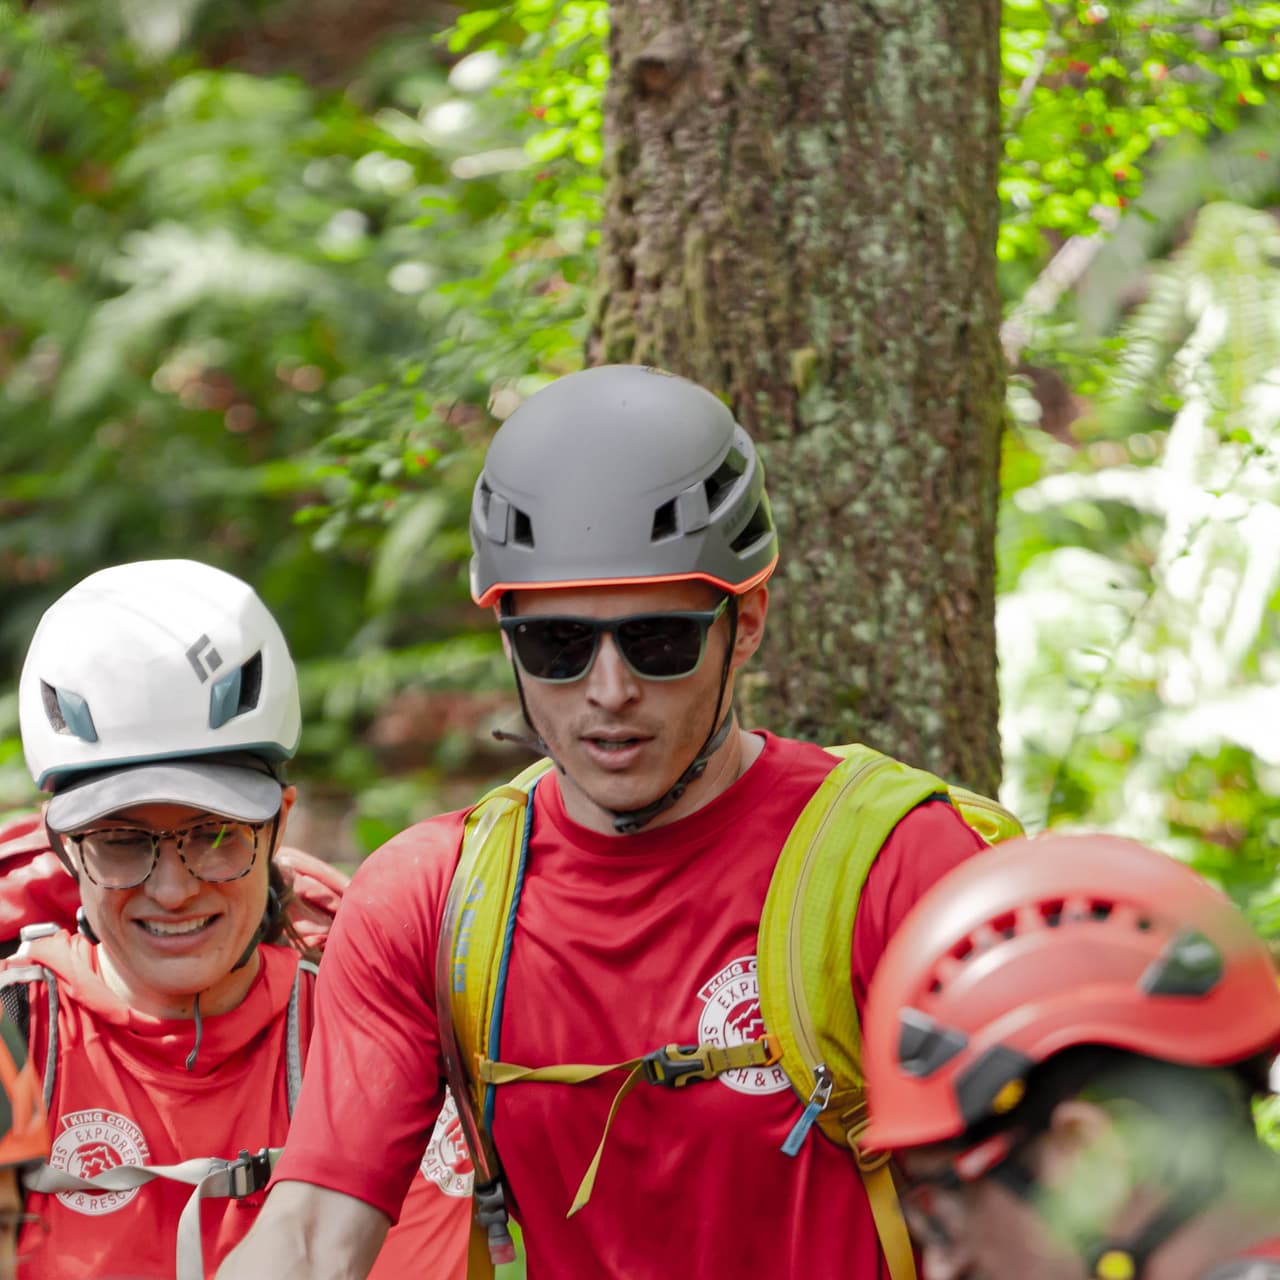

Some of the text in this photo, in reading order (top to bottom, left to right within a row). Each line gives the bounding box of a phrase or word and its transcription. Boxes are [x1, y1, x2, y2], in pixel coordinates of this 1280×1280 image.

[453, 909, 476, 993] BLUE ICE
[708, 963, 743, 993] KING
[718, 982, 758, 1009] EXPL
[754, 1074, 766, 1087] &
[70, 1112, 148, 1153] KING COUNTY
[75, 1127, 137, 1167] EXPLORER
[75, 1196, 84, 1208] &
